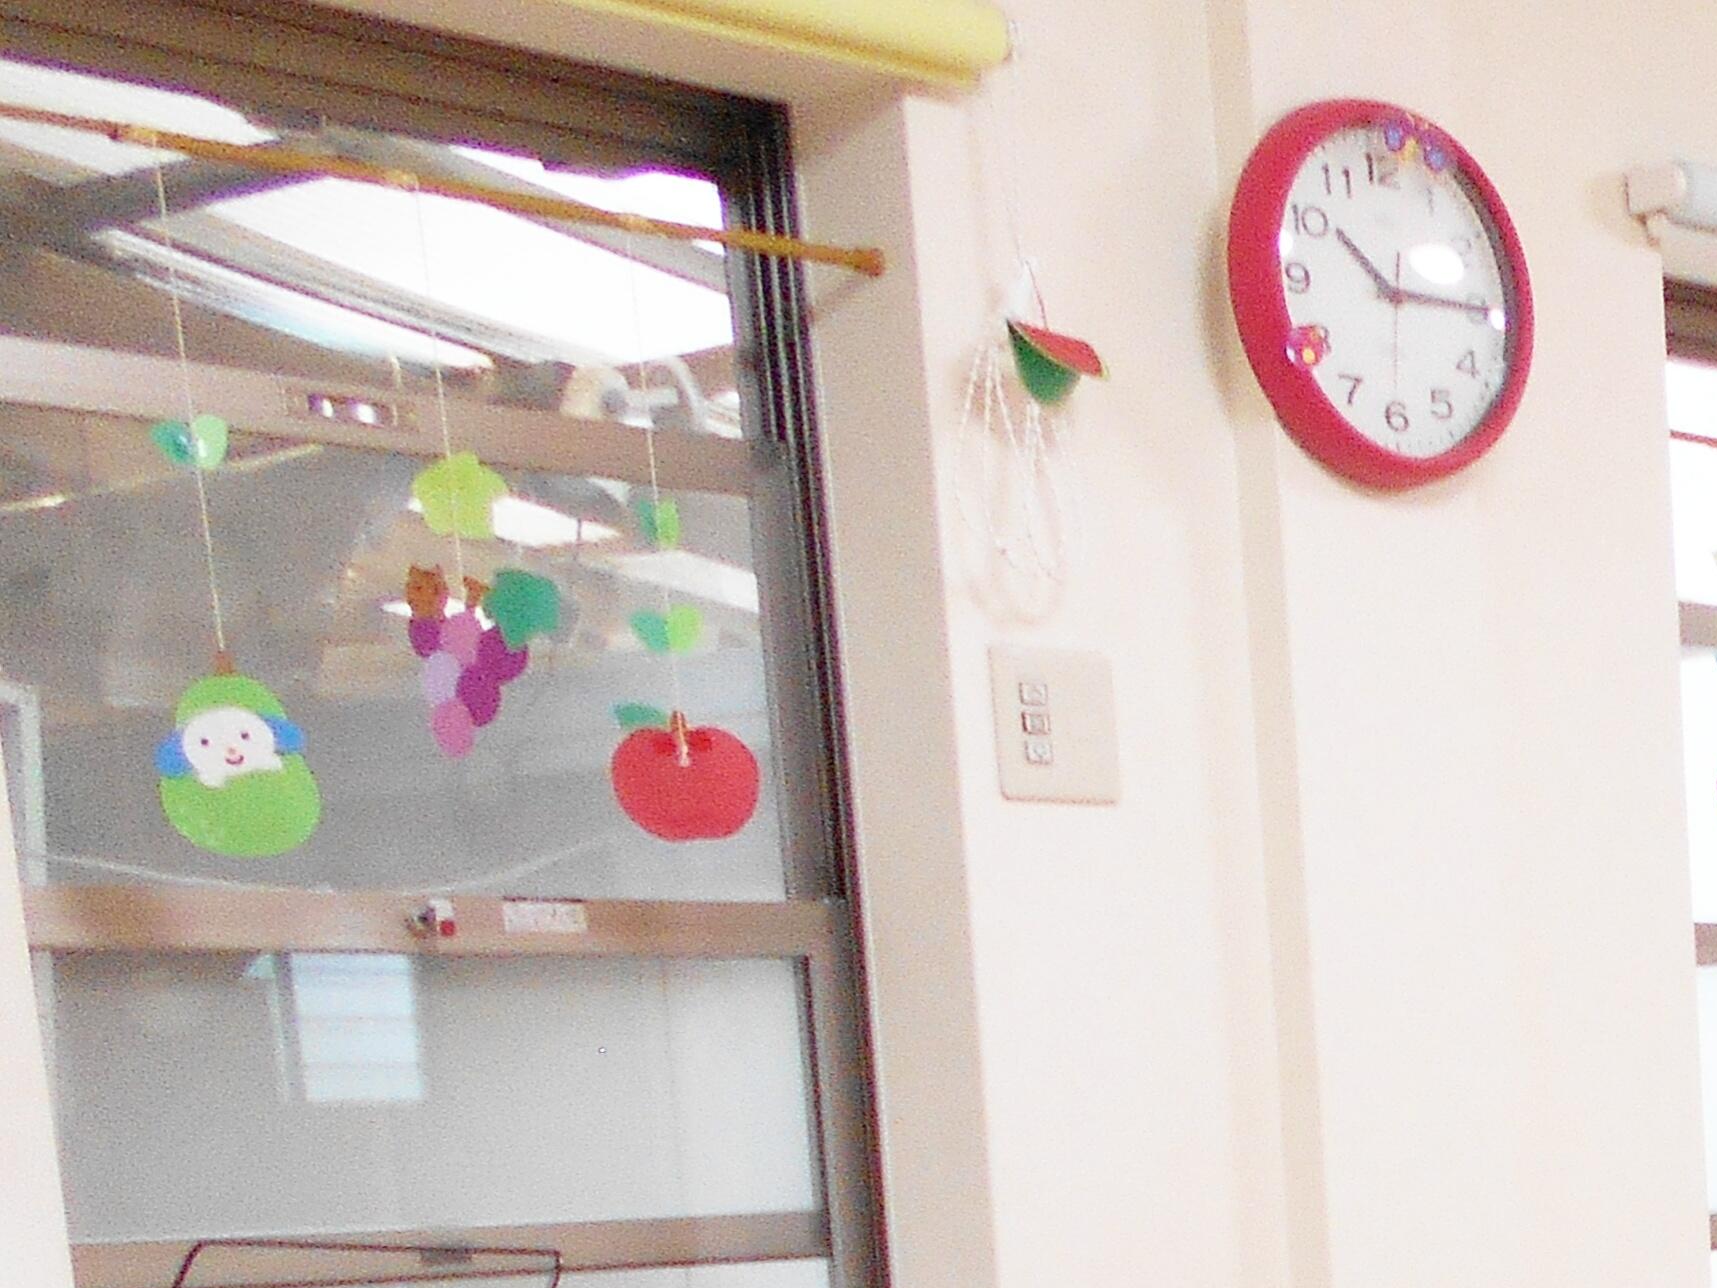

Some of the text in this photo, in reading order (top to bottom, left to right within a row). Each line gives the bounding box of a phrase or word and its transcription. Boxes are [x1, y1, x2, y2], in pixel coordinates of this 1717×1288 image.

[1321, 161, 1353, 199] 11
[1291, 203, 1329, 238] 10
[1284, 262, 1311, 294] 9
[1456, 350, 1481, 379] 4
[1337, 373, 1363, 405] 7
[1429, 388, 1453, 420] 5
[1384, 400, 1410, 433] 6
